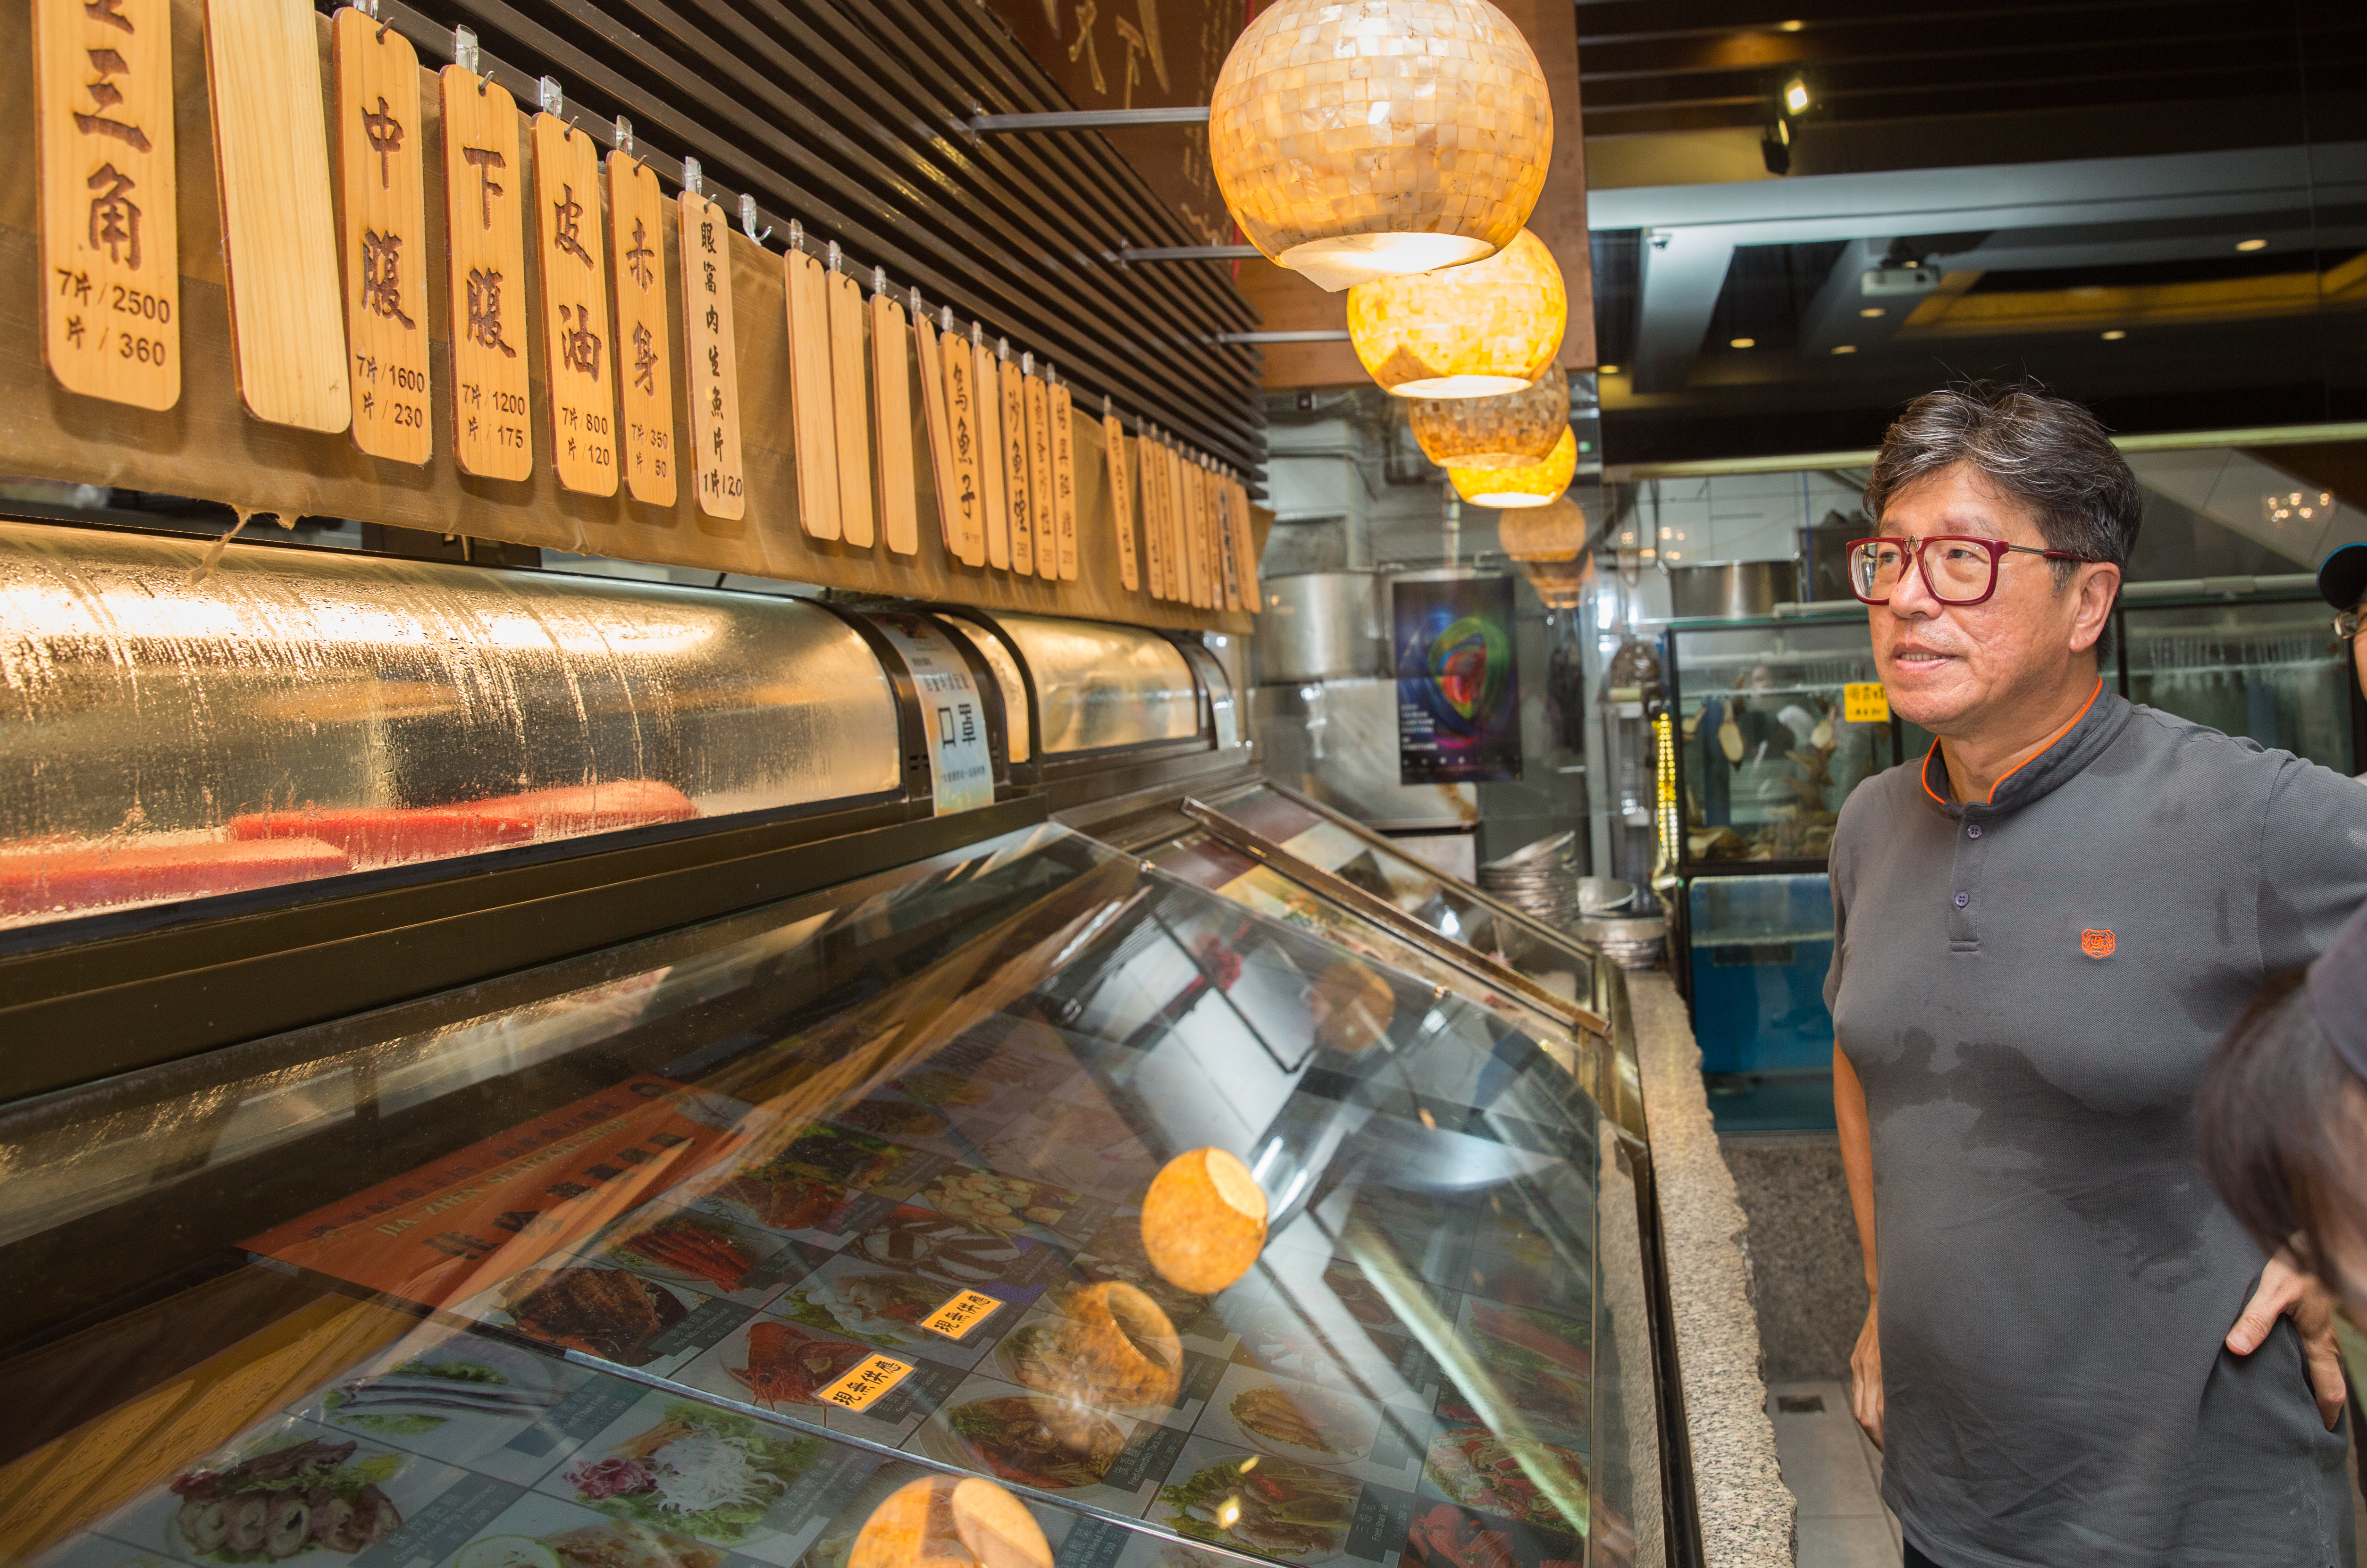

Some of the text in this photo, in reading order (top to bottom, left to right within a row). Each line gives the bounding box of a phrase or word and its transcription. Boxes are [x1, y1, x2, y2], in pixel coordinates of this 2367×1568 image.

[361, 96, 417, 331] 中腹
[462, 146, 517, 359] 下腹
[554, 182, 602, 383] 皮油
[626, 218, 659, 399] 赤身
[700, 221, 725, 462] 眼窩肉生魚片
[374, 1218, 420, 1238] JIA
[418, 1185, 485, 1216] ZHEN
[832, 1359, 901, 1406] 現無供應
[934, 1294, 990, 1333] 現無供應
[1088, 1534, 1103, 1551] Head
